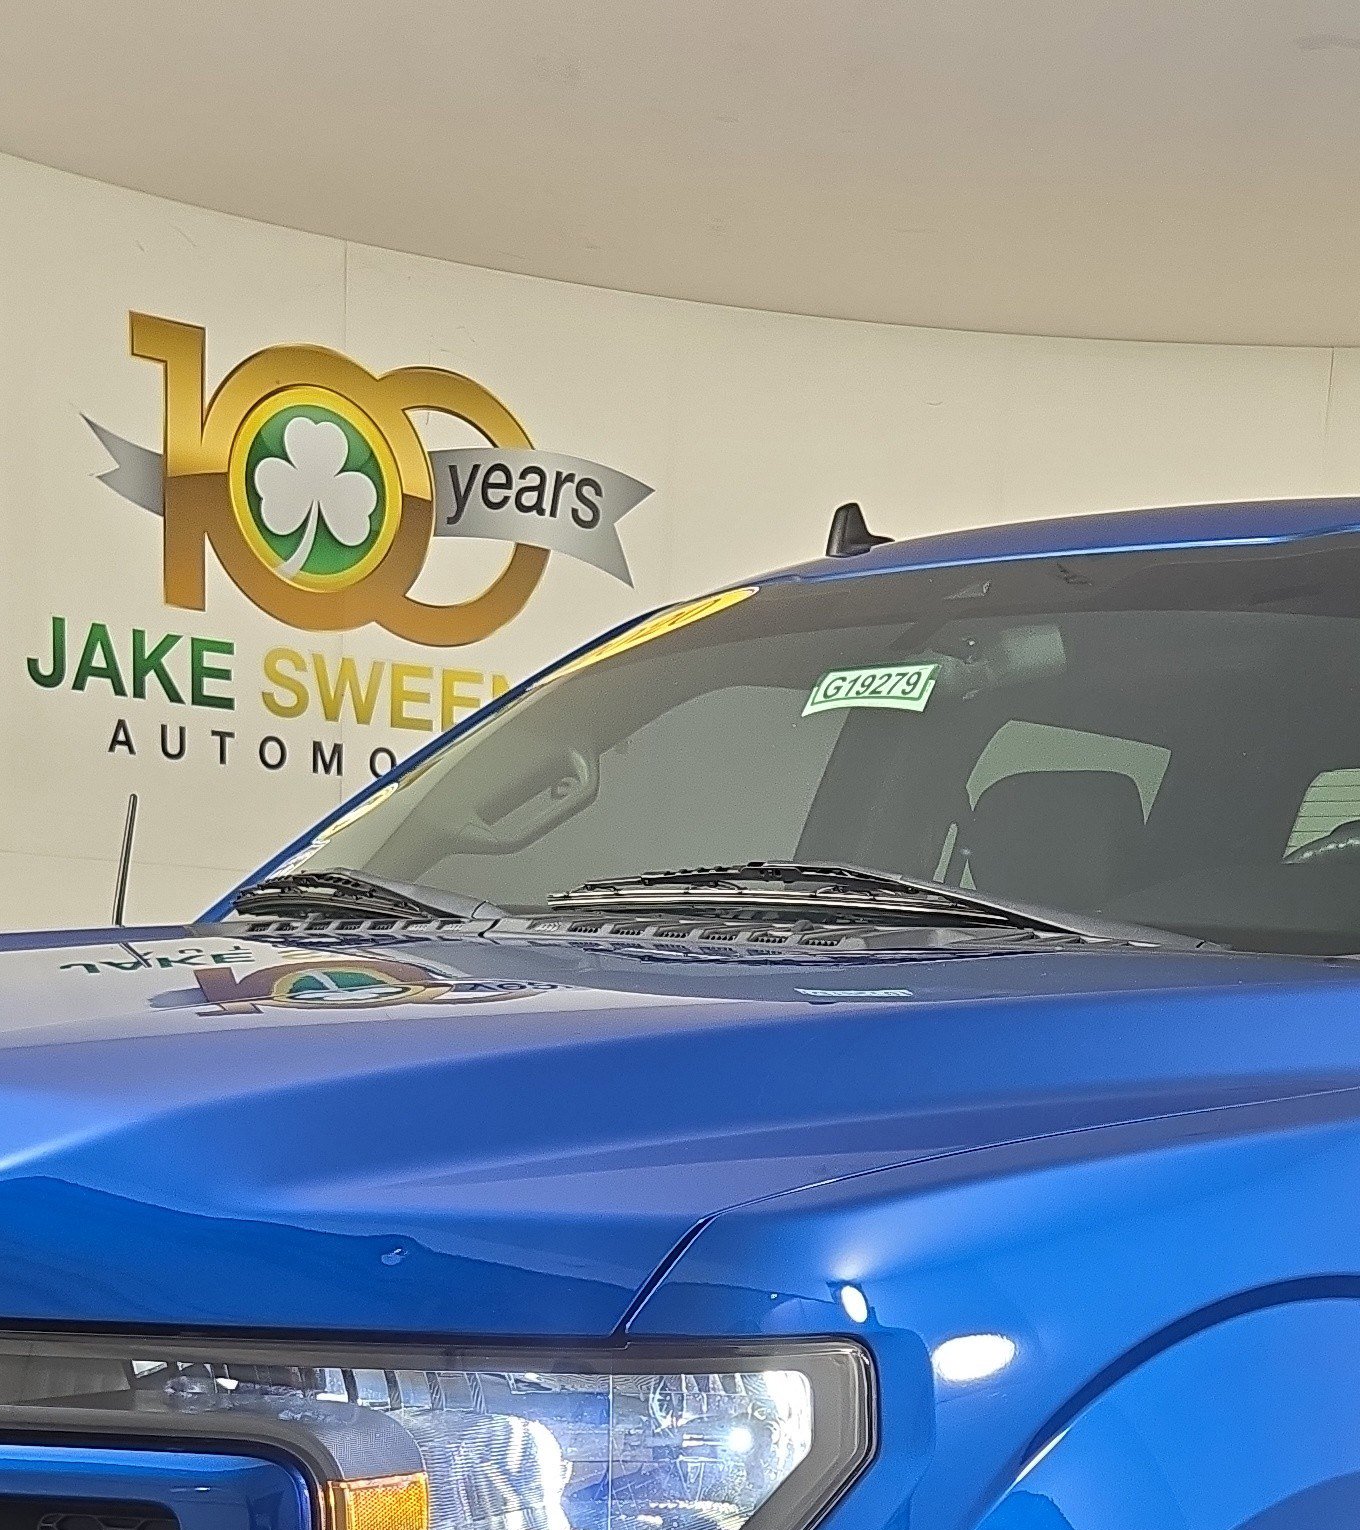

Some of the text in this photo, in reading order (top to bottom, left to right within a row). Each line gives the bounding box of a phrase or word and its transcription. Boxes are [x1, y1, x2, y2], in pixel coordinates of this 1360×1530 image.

[446, 461, 604, 530] years
[27, 616, 235, 711] JAKE
[822, 671, 922, 699] G19279
[107, 718, 397, 779] AUTOMO
